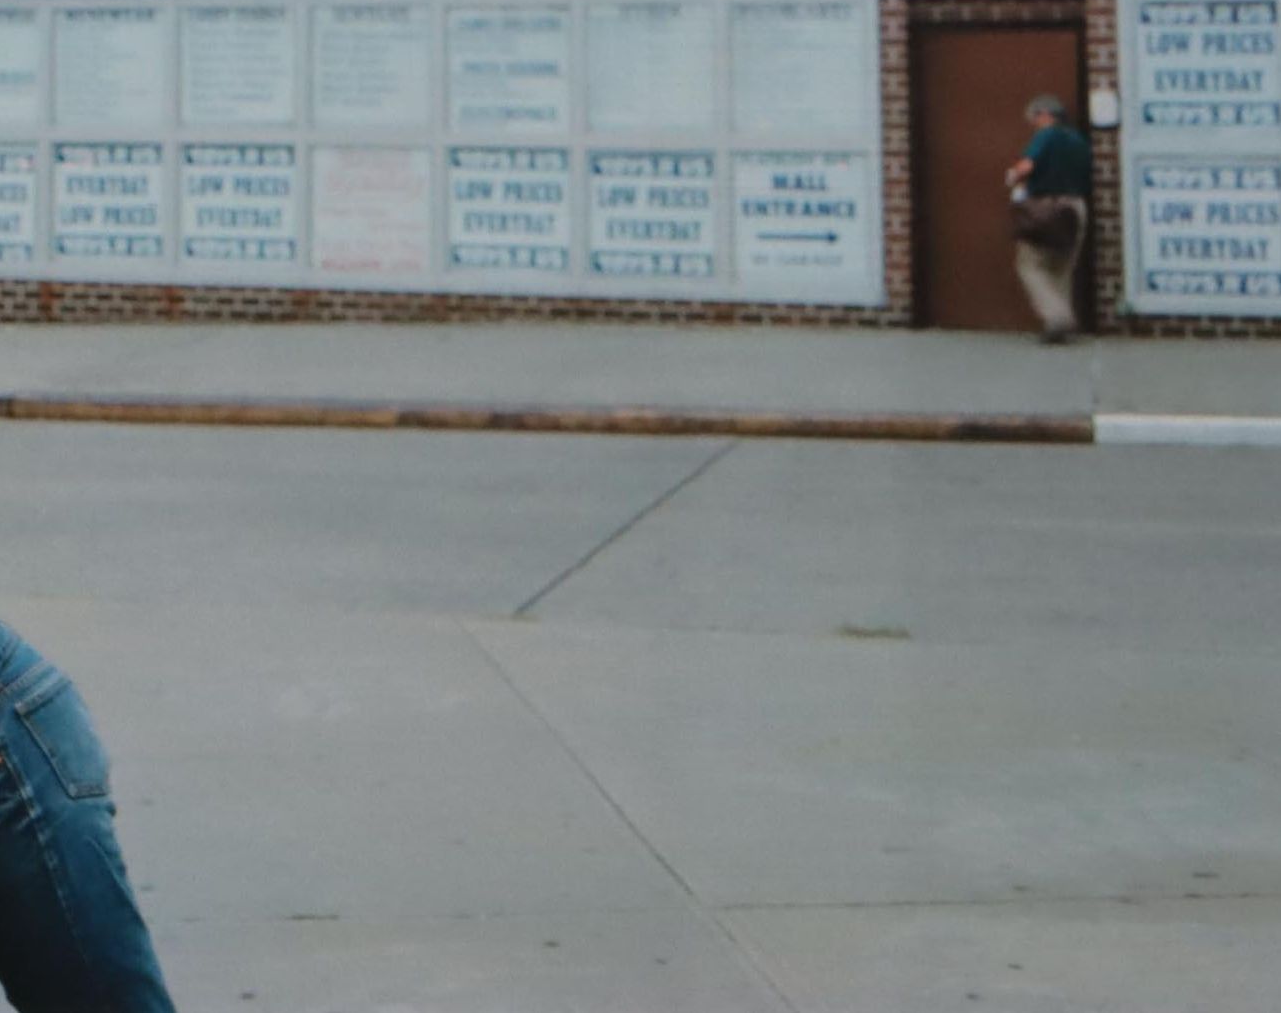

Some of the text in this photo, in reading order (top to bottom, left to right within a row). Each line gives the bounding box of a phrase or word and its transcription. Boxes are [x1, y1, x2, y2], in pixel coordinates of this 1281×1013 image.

[1146, 31, 1274, 55] LOW PRICES
[1154, 69, 1263, 92] EVERYDAY
[773, 173, 828, 191] MALL
[741, 199, 857, 218] ENTRANCE
[1149, 200, 1280, 224] LOW PRICES
[1159, 235, 1268, 259] EVERYDAY
